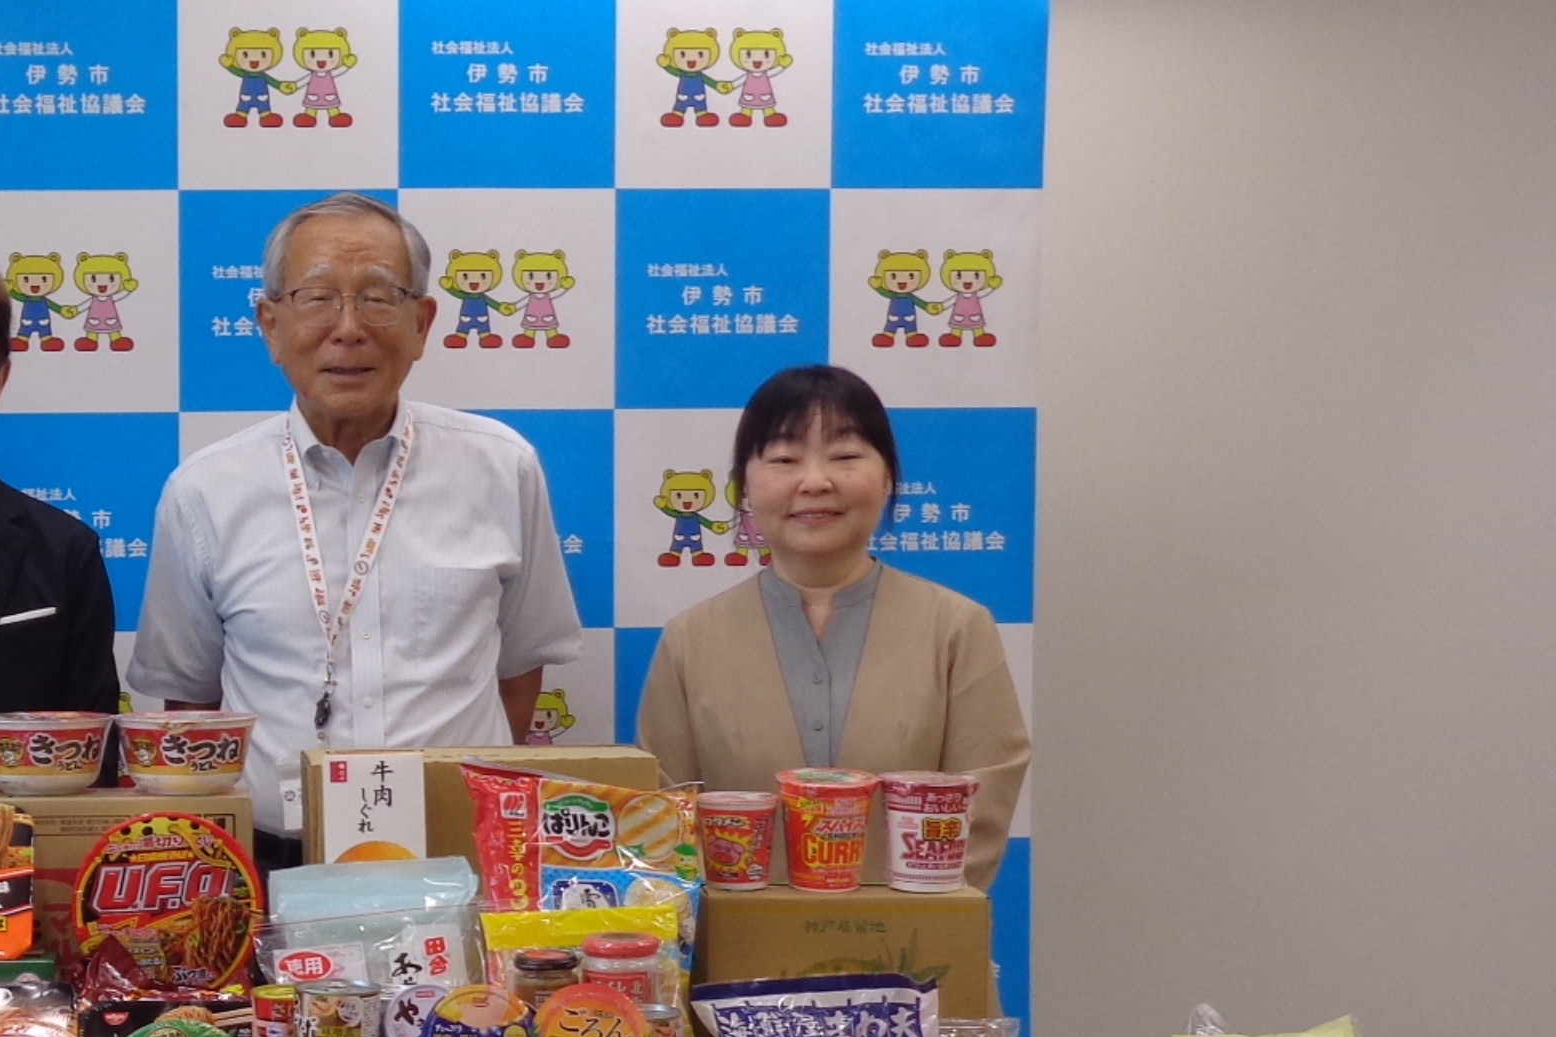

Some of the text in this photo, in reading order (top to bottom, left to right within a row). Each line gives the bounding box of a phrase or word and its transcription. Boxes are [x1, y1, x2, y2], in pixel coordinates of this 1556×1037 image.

[431, 41, 513, 55] 社会福祉法人
[864, 41, 946, 56] 社会福祉法人
[26, 63, 110, 86] 伊勢市
[466, 62, 549, 84] 伊勢市
[899, 64, 980, 86] 伊勢市
[431, 92, 585, 114] 社会福祉協議会
[863, 93, 1015, 115] 社会福祉協議会
[647, 263, 728, 278] 社会福祉法人
[681, 286, 763, 306] 伊勢市
[646, 314, 798, 336] 社会福祉協議会
[29, 735, 100, 765] きつね
[163, 735, 240, 765] きつね
[189, 761, 217, 772] うどん
[371, 760, 394, 808] 牛肉
[356, 787, 376, 834] しぐれ
[544, 808, 610, 838] ぱりんこ
[922, 817, 961, 840] 旨辛
[803, 835, 865, 864] CURR
